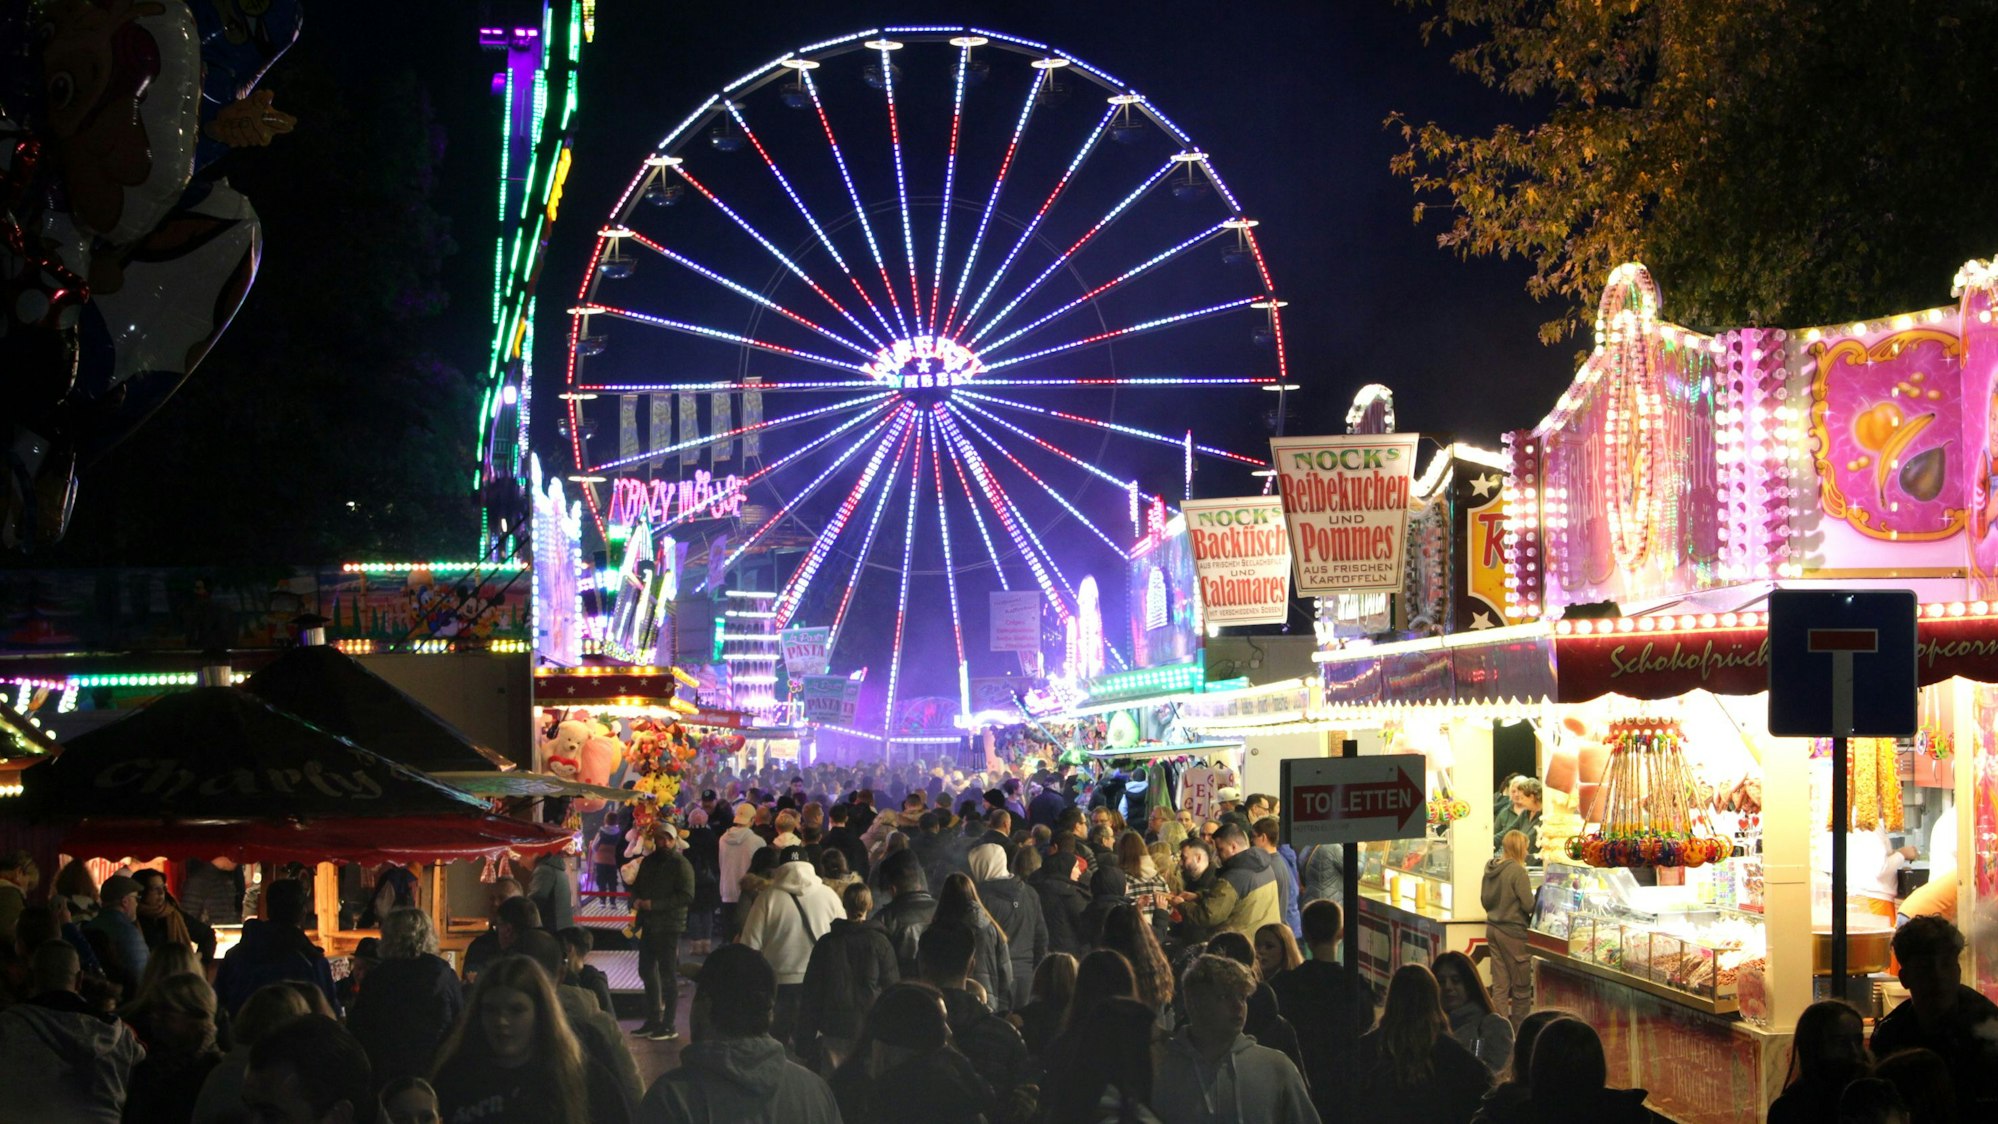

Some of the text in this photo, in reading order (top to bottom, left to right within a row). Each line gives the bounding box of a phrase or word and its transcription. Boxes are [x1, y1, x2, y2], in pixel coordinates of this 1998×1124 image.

[1293, 448, 1400, 470] NOCKS
[1280, 470, 1409, 514] Reibekuchen
[1329, 515, 1364, 525] UND
[1191, 524, 1287, 561] Backfisch
[1299, 522, 1395, 563] Pommes
[1199, 561, 1212, 569] AUS
[1212, 560, 1241, 569] FRISCHEN
[1230, 569, 1256, 577] UND
[1304, 563, 1393, 574] AUS FRISCHEN
[1310, 574, 1387, 585] KARTOFFELN
[1200, 575, 1285, 608] Calamares
[786, 643, 825, 659] PASTA
[1917, 637, 1998, 669] opcorn
[807, 697, 841, 713] PASTA
[1302, 788, 1412, 814] TOILETTEN
